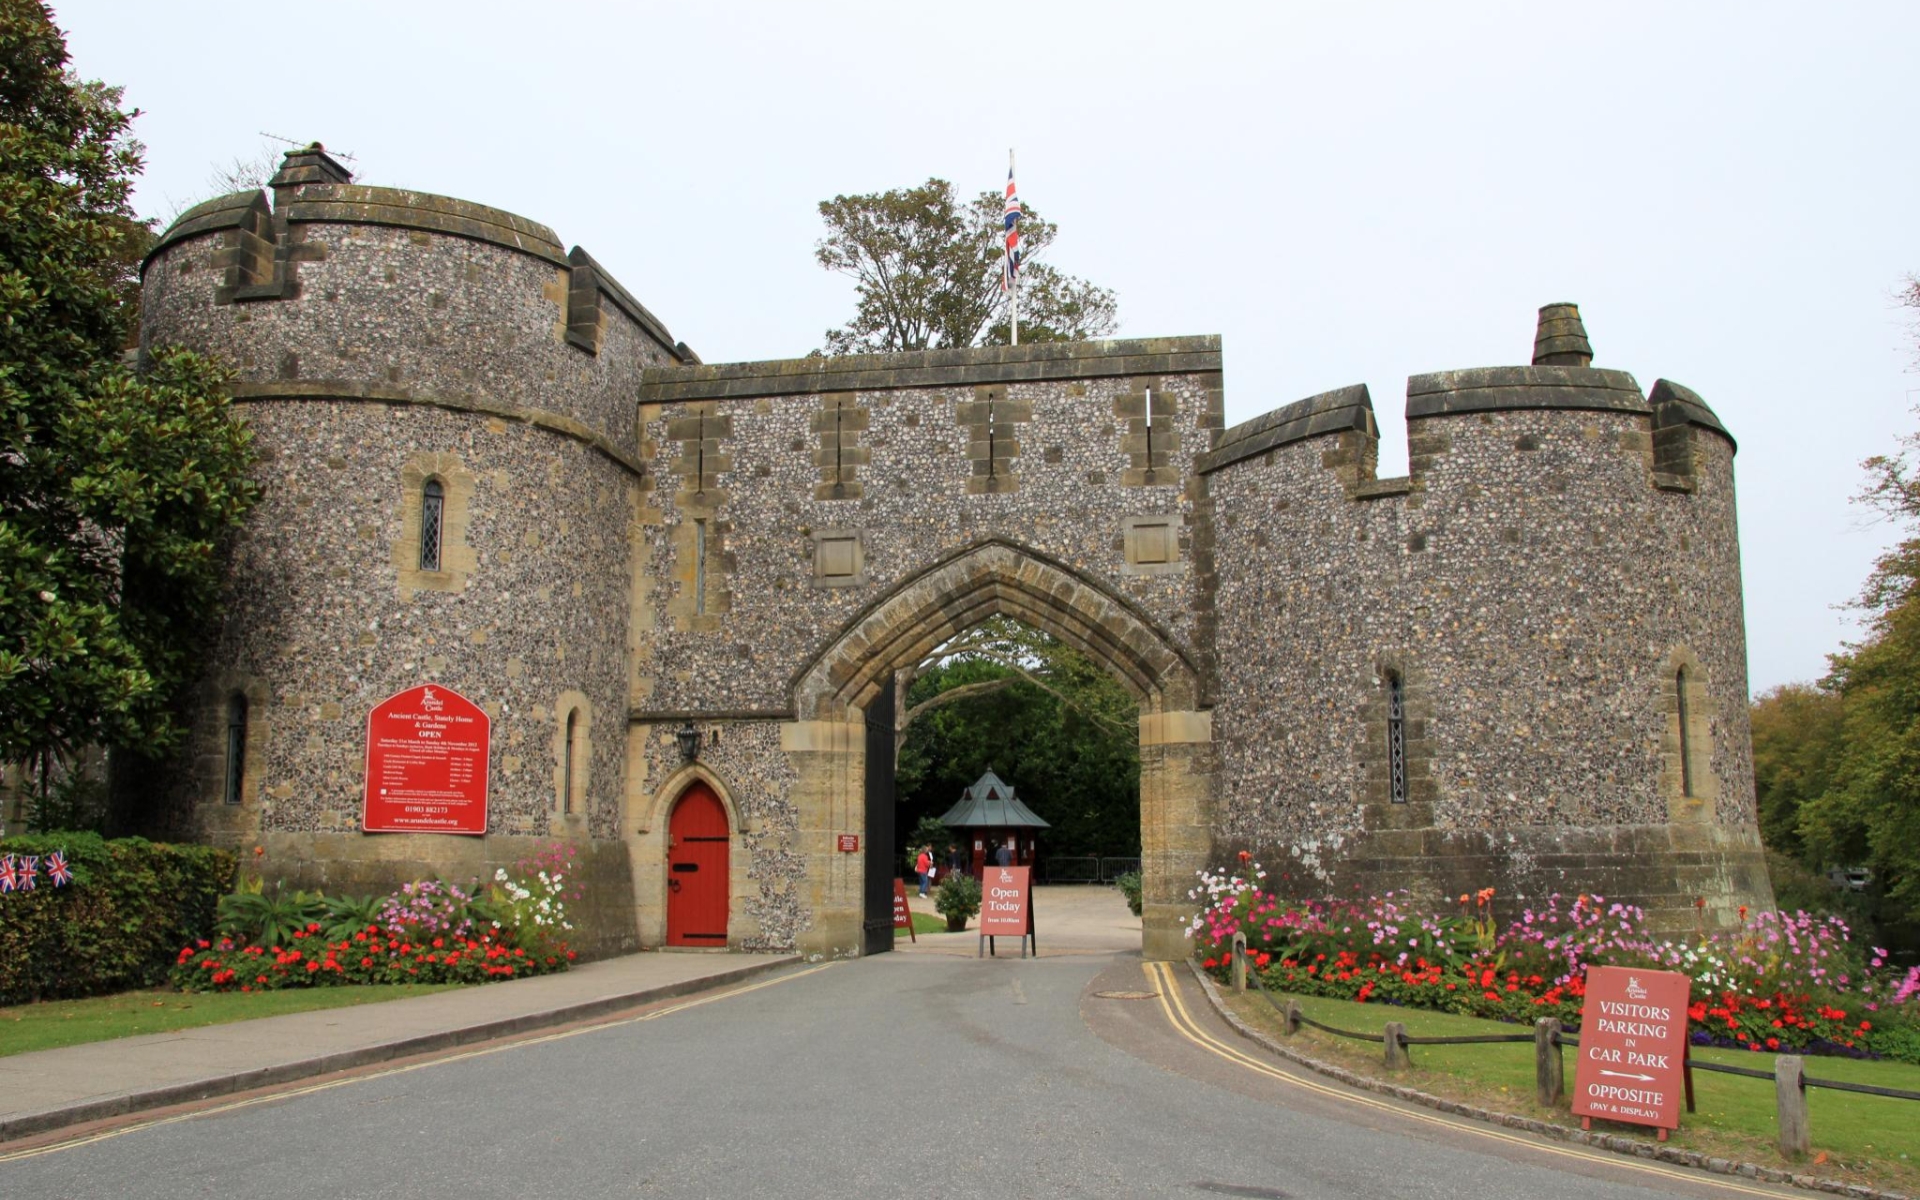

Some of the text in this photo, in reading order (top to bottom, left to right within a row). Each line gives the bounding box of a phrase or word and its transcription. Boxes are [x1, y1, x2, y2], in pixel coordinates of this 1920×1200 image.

[388, 712, 411, 720] Ancient
[434, 714, 454, 722] Stately
[394, 816, 458, 826] www.arundelcastle.org
[991, 887, 1018, 900] Open
[989, 901, 1020, 913] Today
[1600, 1001, 1670, 1021] VISITORS
[1598, 1019, 1667, 1039] PARKING
[1625, 1039, 1636, 1047] IN
[1589, 1047, 1669, 1069] CAR PARK
[1588, 1083, 1663, 1106] OPPOSITE
[1590, 1102, 1608, 1111] (PAY
[1620, 1106, 1658, 1119] DISPLAY)
